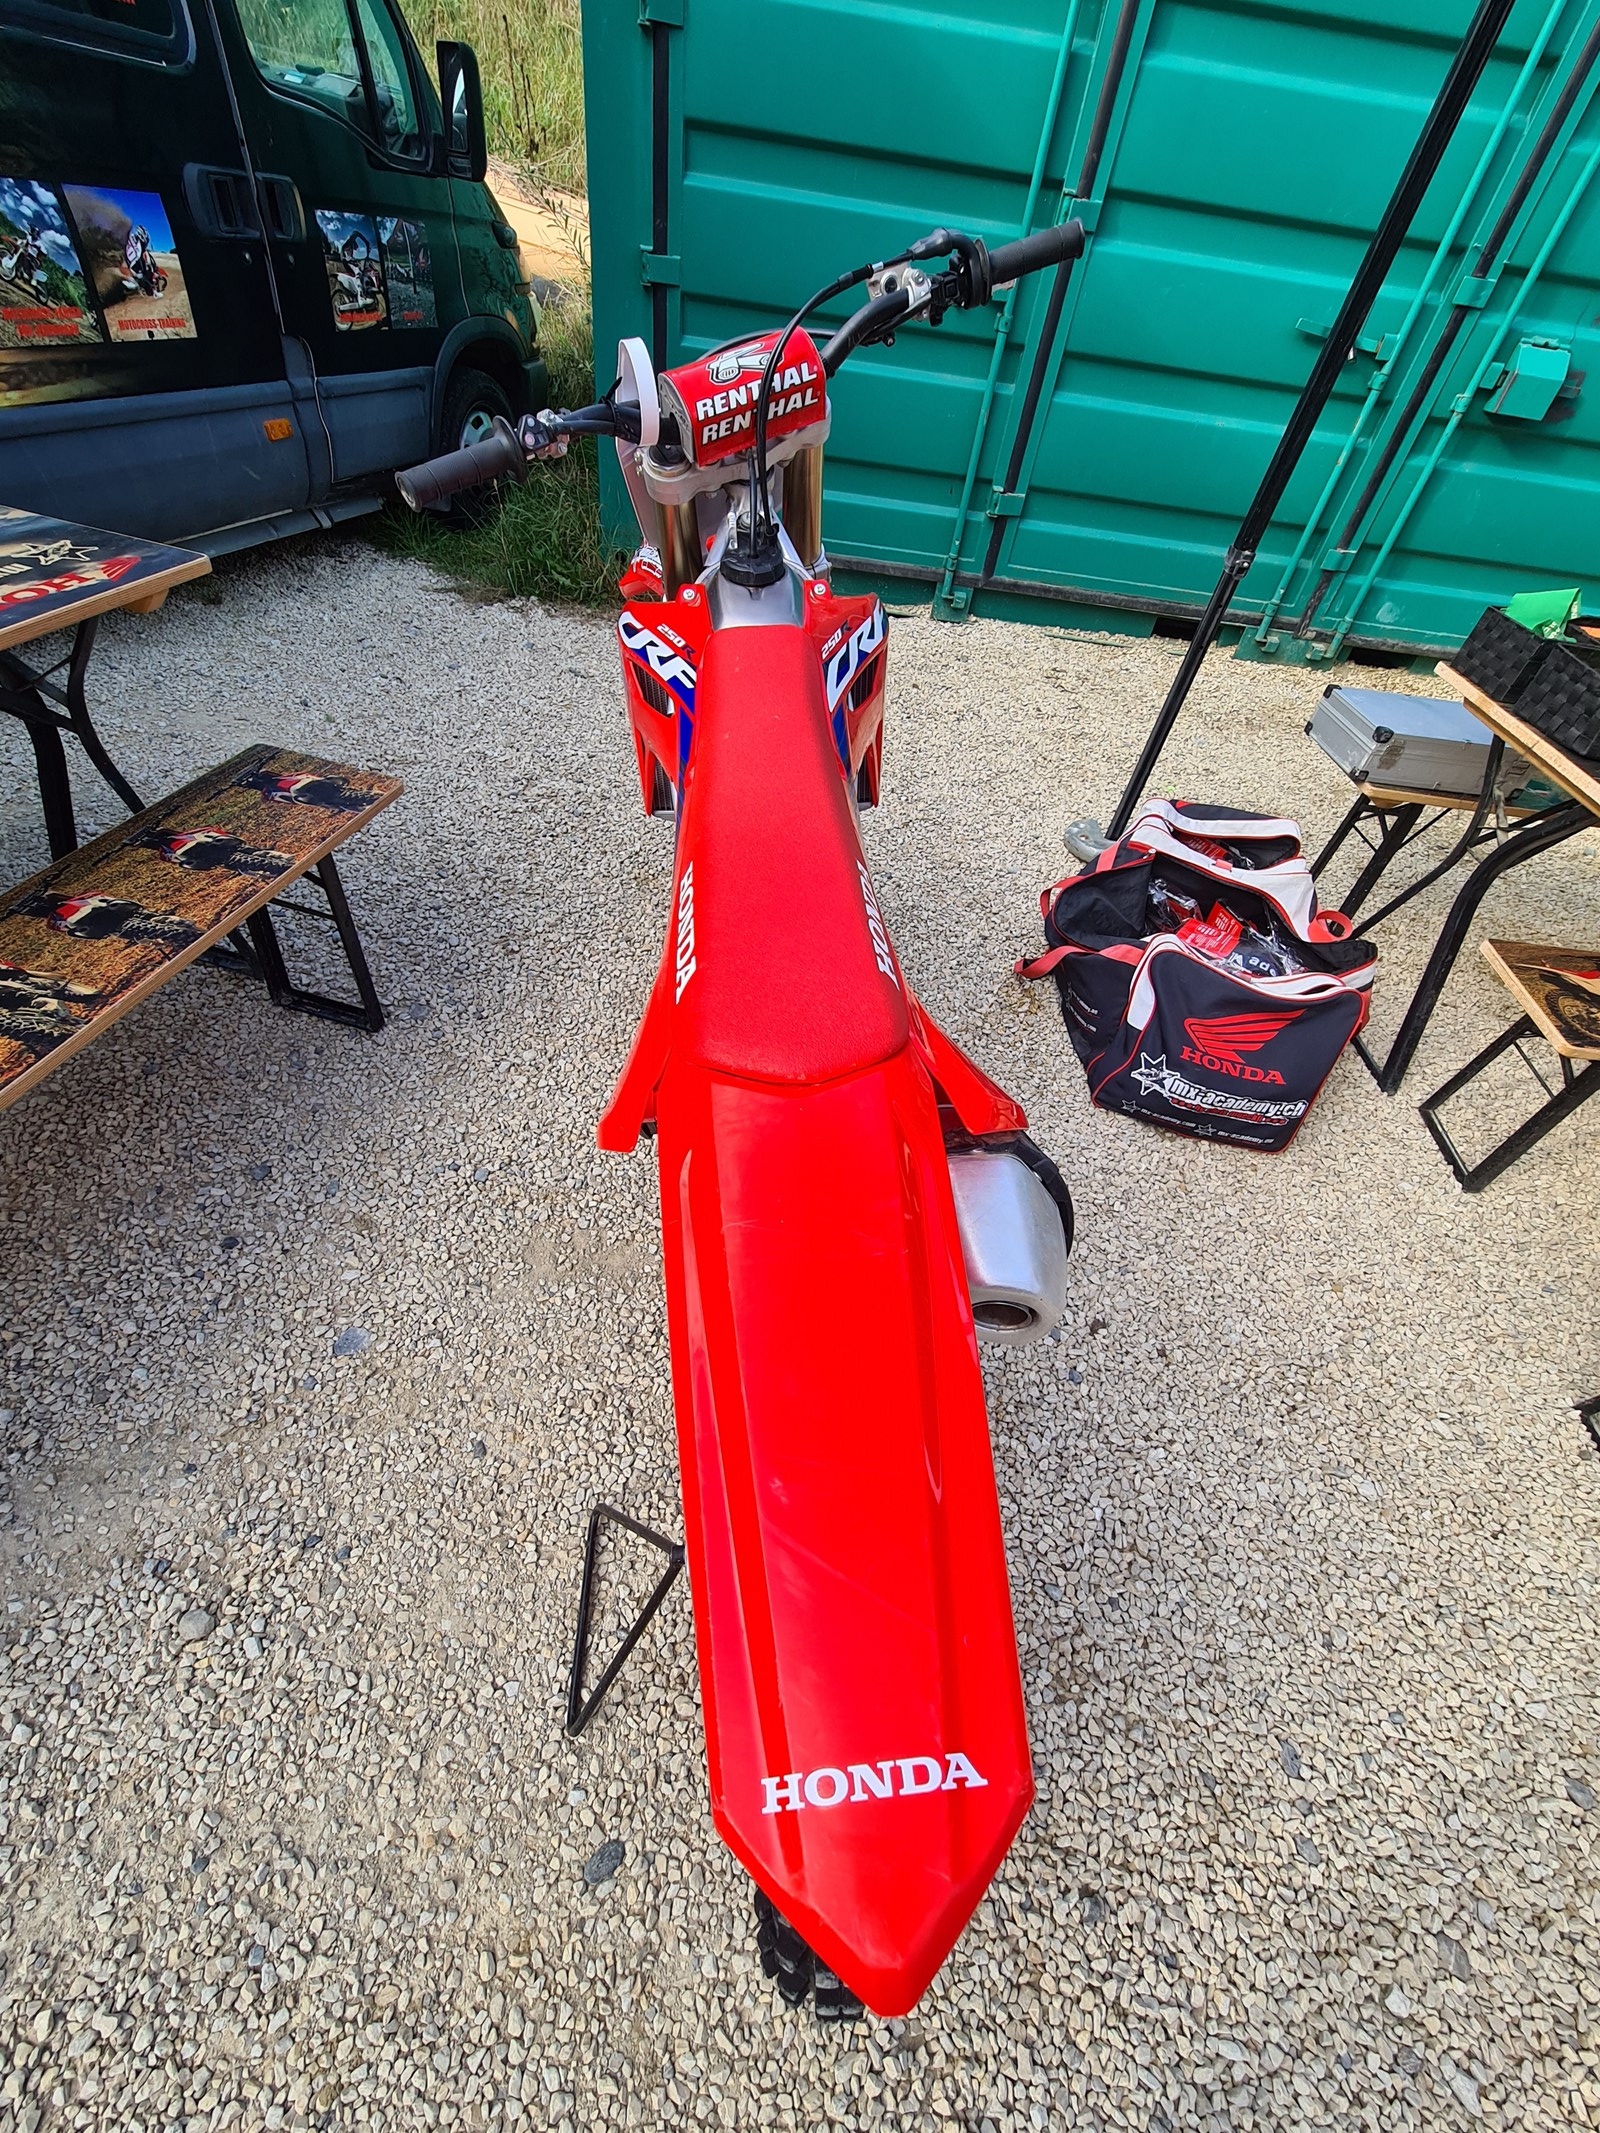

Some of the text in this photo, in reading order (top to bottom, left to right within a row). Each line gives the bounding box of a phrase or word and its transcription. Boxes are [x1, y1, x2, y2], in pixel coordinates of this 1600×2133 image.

[702, 387, 819, 446] RENHAL
[618, 611, 697, 689] CRF
[675, 861, 697, 1005] HONDA
[1180, 1045, 1286, 1086] HONDA
[761, 1752, 989, 1815] HONDA
